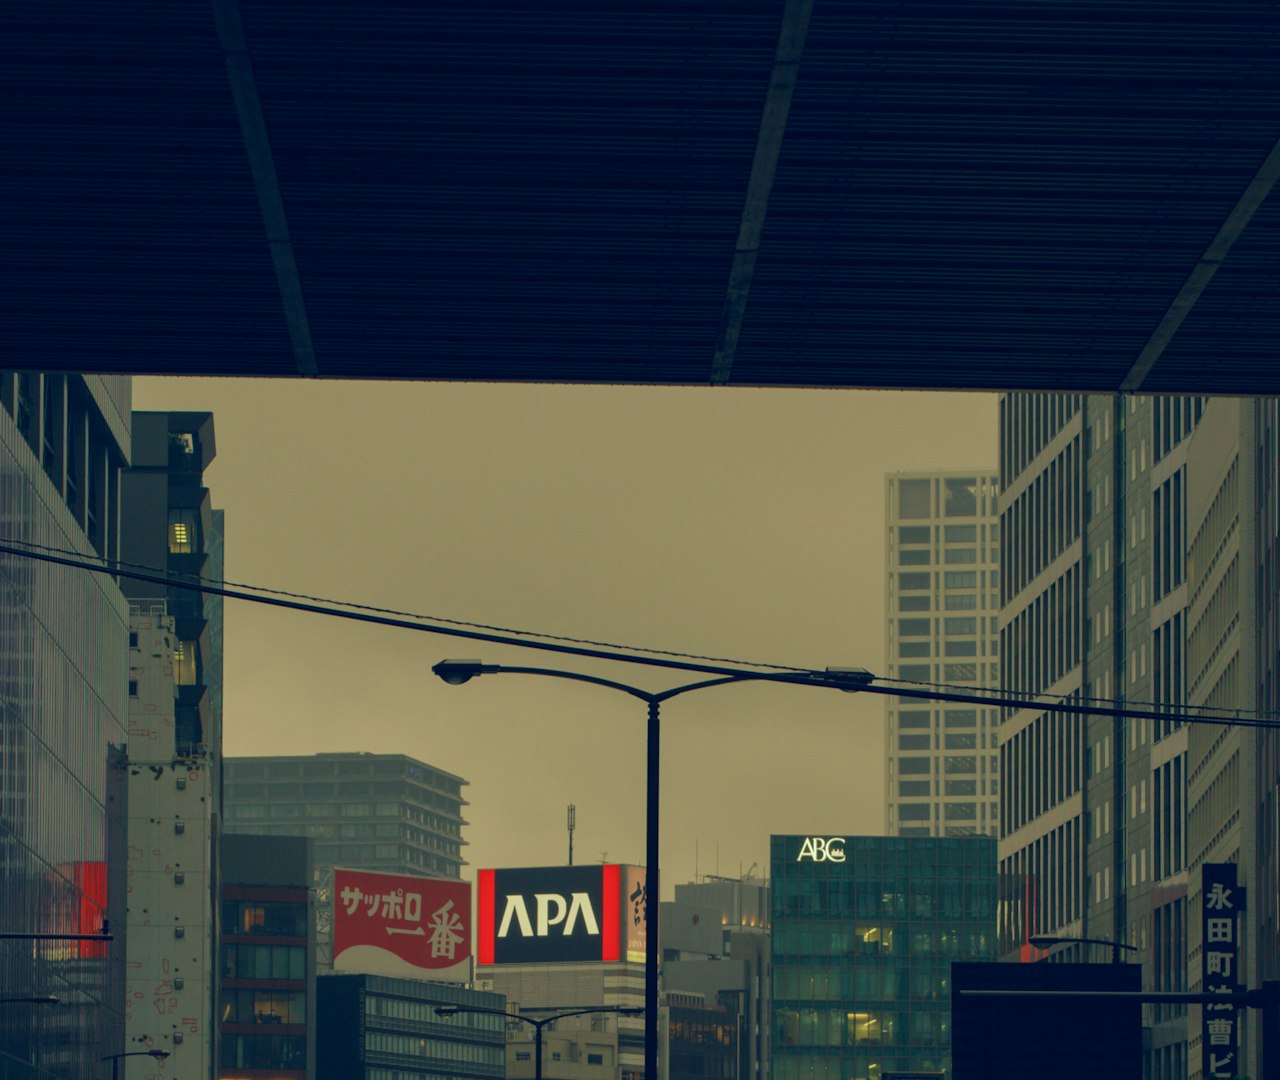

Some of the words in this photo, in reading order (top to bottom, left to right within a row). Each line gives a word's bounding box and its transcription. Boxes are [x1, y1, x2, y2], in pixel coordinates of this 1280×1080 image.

[797, 837, 846, 862] ABC
[340, 886, 422, 922] サッポロ
[497, 892, 600, 938] APA
[386, 899, 465, 960] 一番
